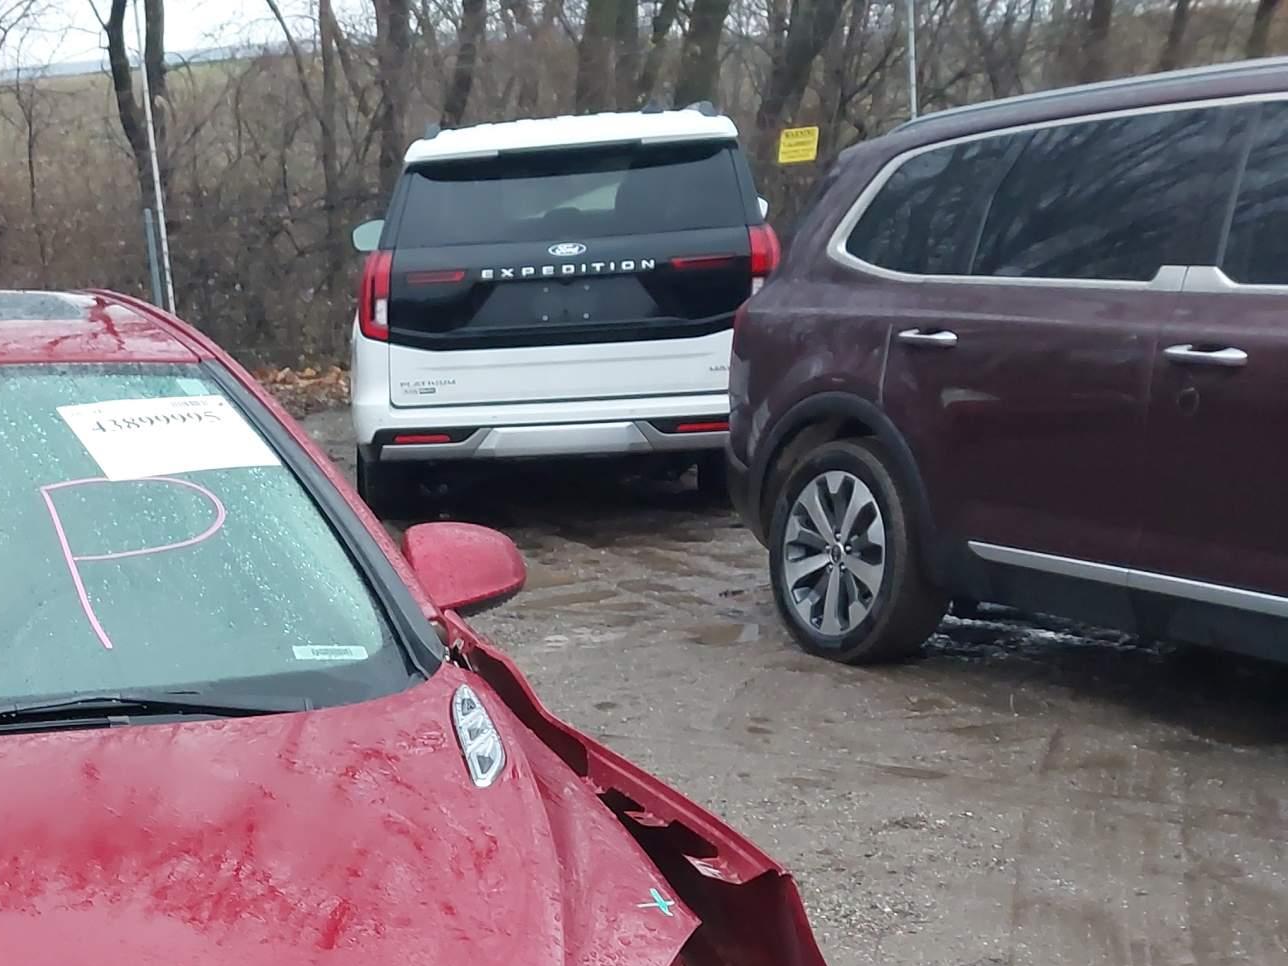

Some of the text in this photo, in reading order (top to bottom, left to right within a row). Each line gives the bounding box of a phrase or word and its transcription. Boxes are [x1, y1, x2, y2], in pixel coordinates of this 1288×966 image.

[552, 243, 583, 256] Ford
[481, 259, 655, 279] EXPEDITION
[40, 477, 226, 649] P
